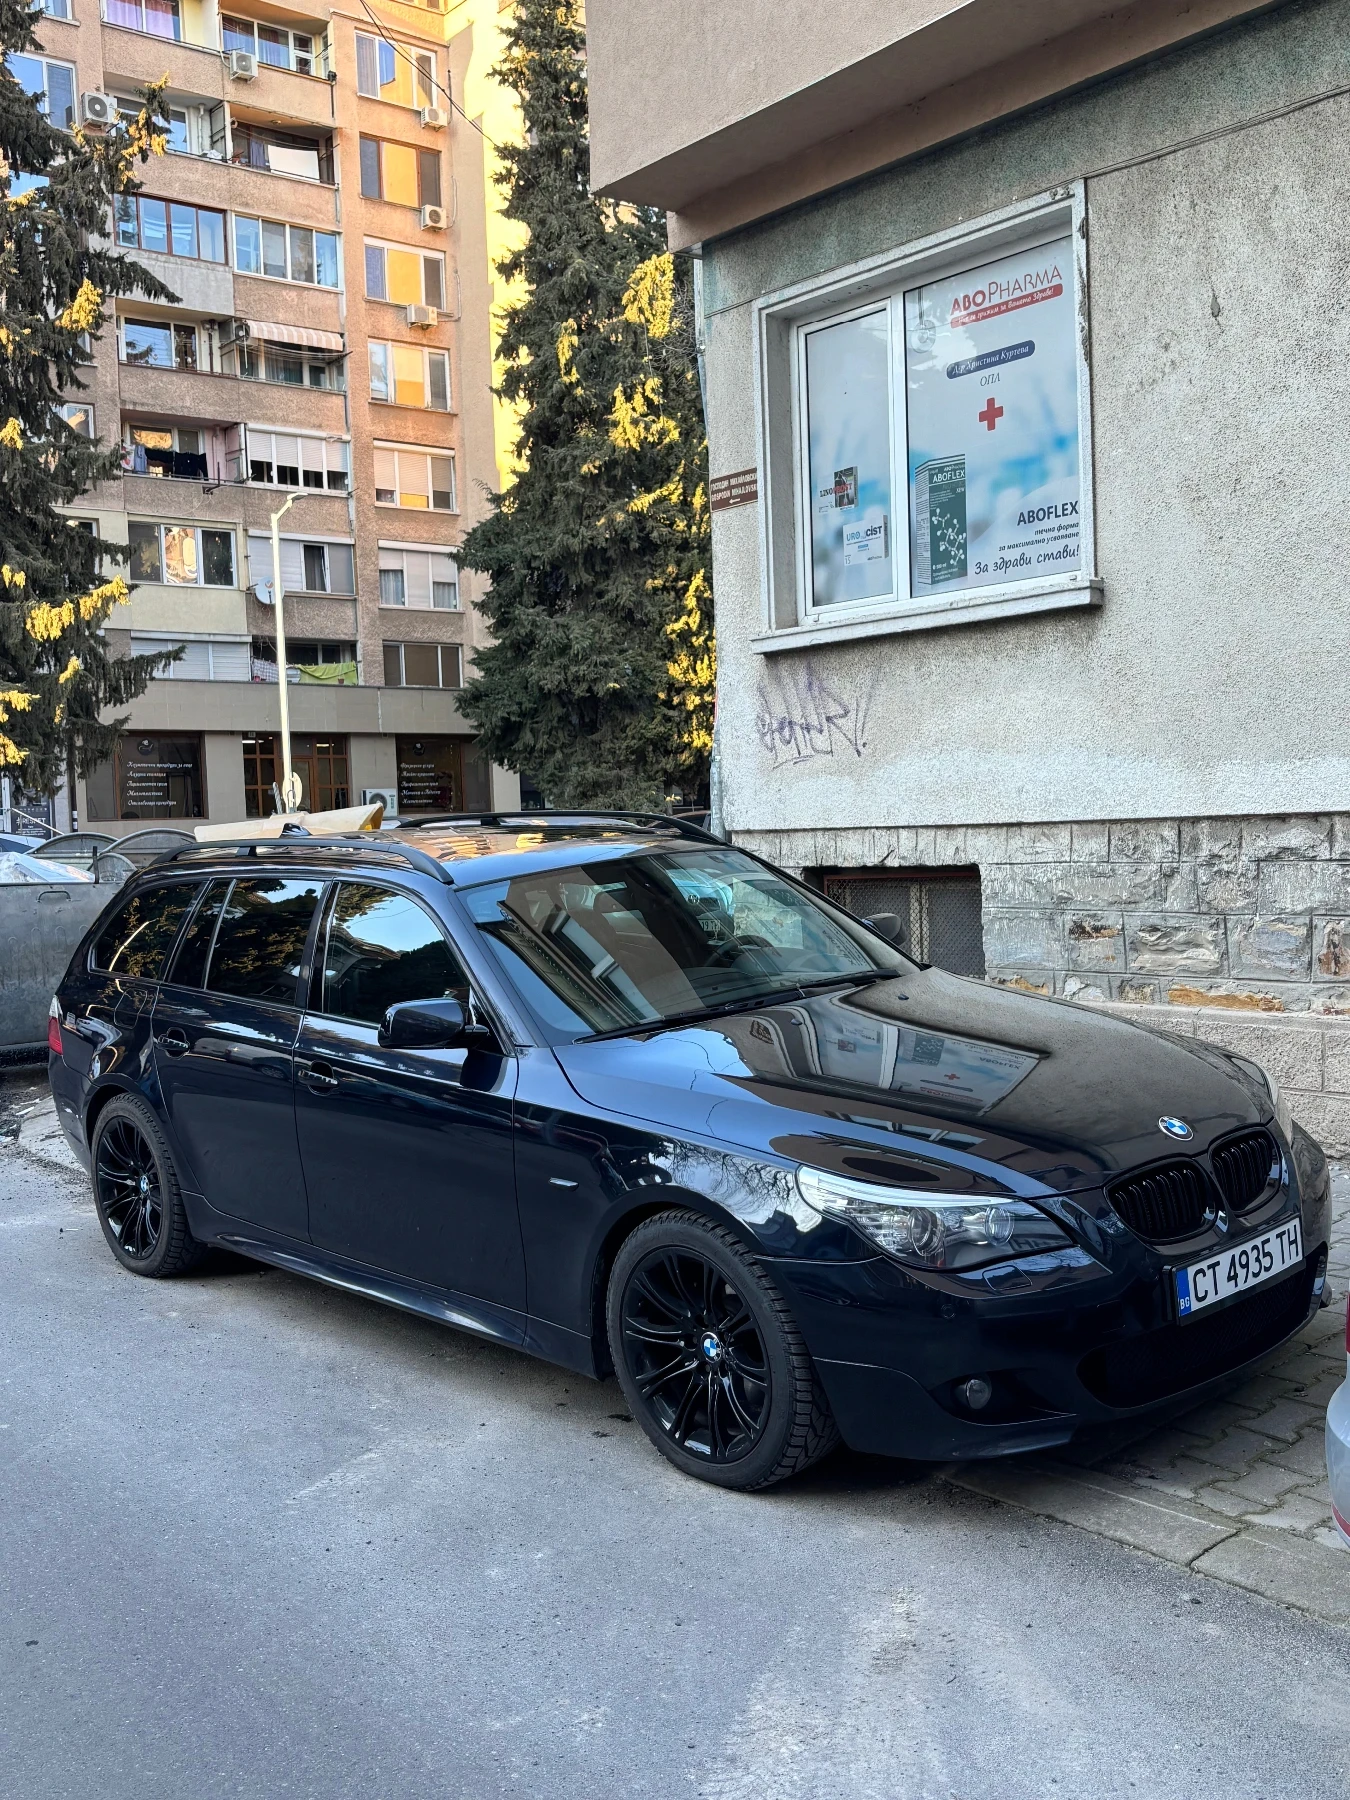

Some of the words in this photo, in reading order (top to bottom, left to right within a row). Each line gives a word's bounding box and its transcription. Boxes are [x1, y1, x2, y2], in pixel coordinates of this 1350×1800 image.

[977, 307, 999, 320] грижим
[966, 354, 1000, 370] Христина
[1000, 345, 1029, 361] Куртева
[980, 372, 1000, 386] ОПЛ
[933, 469, 965, 483] ABOFLEX
[711, 490, 730, 502] GOSPODIN
[1017, 500, 1079, 526] ABOFLEX
[1034, 526, 1055, 536] течна
[1056, 522, 1079, 533] форма
[1006, 538, 1046, 550] максимално
[1046, 531, 1079, 545] усвояване
[974, 562, 989, 575] За
[992, 552, 1032, 574] здрави
[1036, 544, 1080, 564] стави!
[1192, 1260, 1221, 1303] CT
[1226, 1237, 1274, 1289] 4935
[1275, 1223, 1299, 1265] TH
[1180, 1296, 1190, 1310] BG
